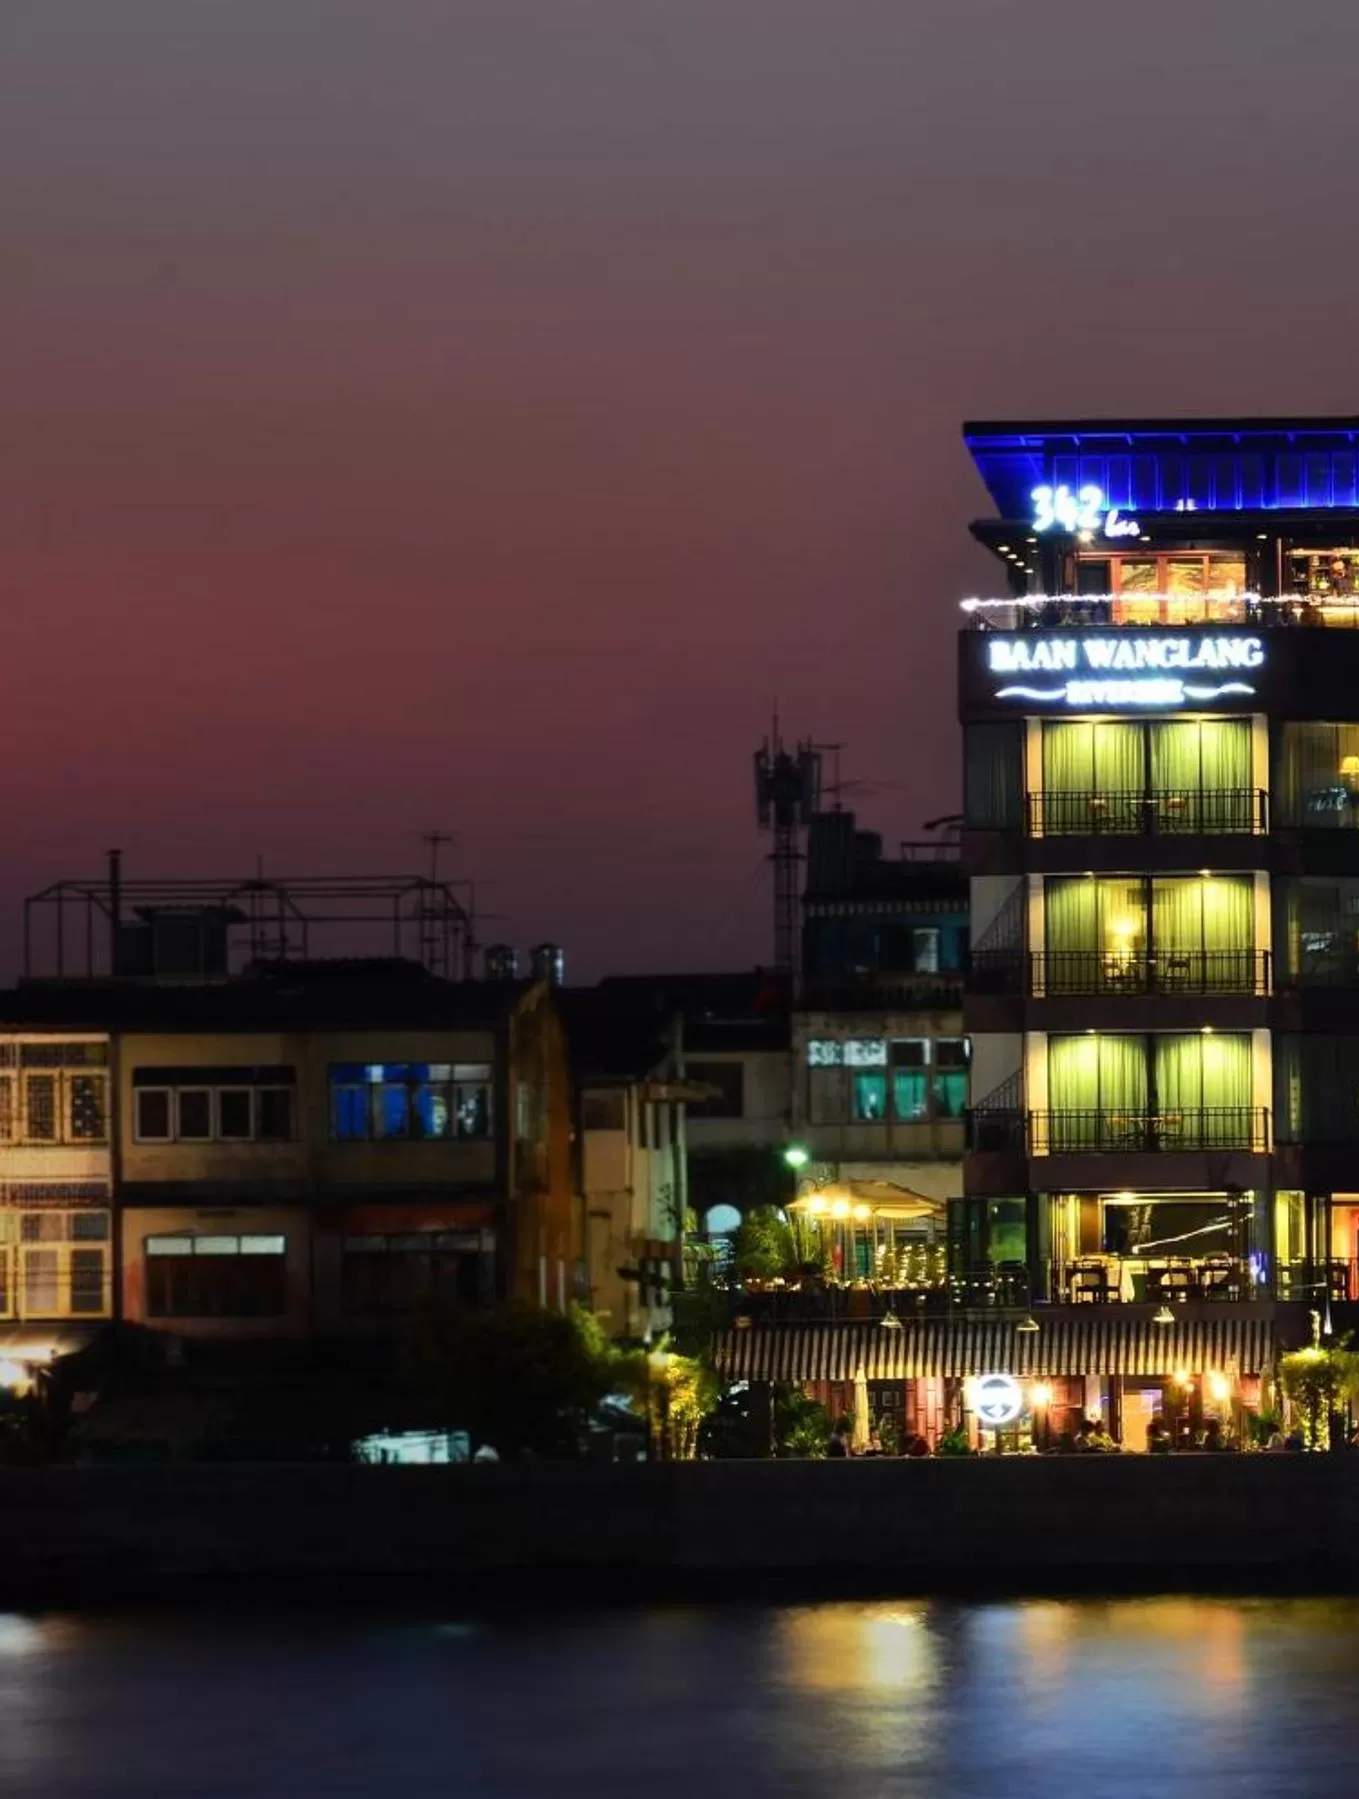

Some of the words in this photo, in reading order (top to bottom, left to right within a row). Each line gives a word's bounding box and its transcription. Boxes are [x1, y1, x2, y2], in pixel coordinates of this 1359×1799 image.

[1031, 485, 1102, 532] 342
[989, 640, 1076, 670] BAAN
[1082, 638, 1265, 668] WANGLANG
